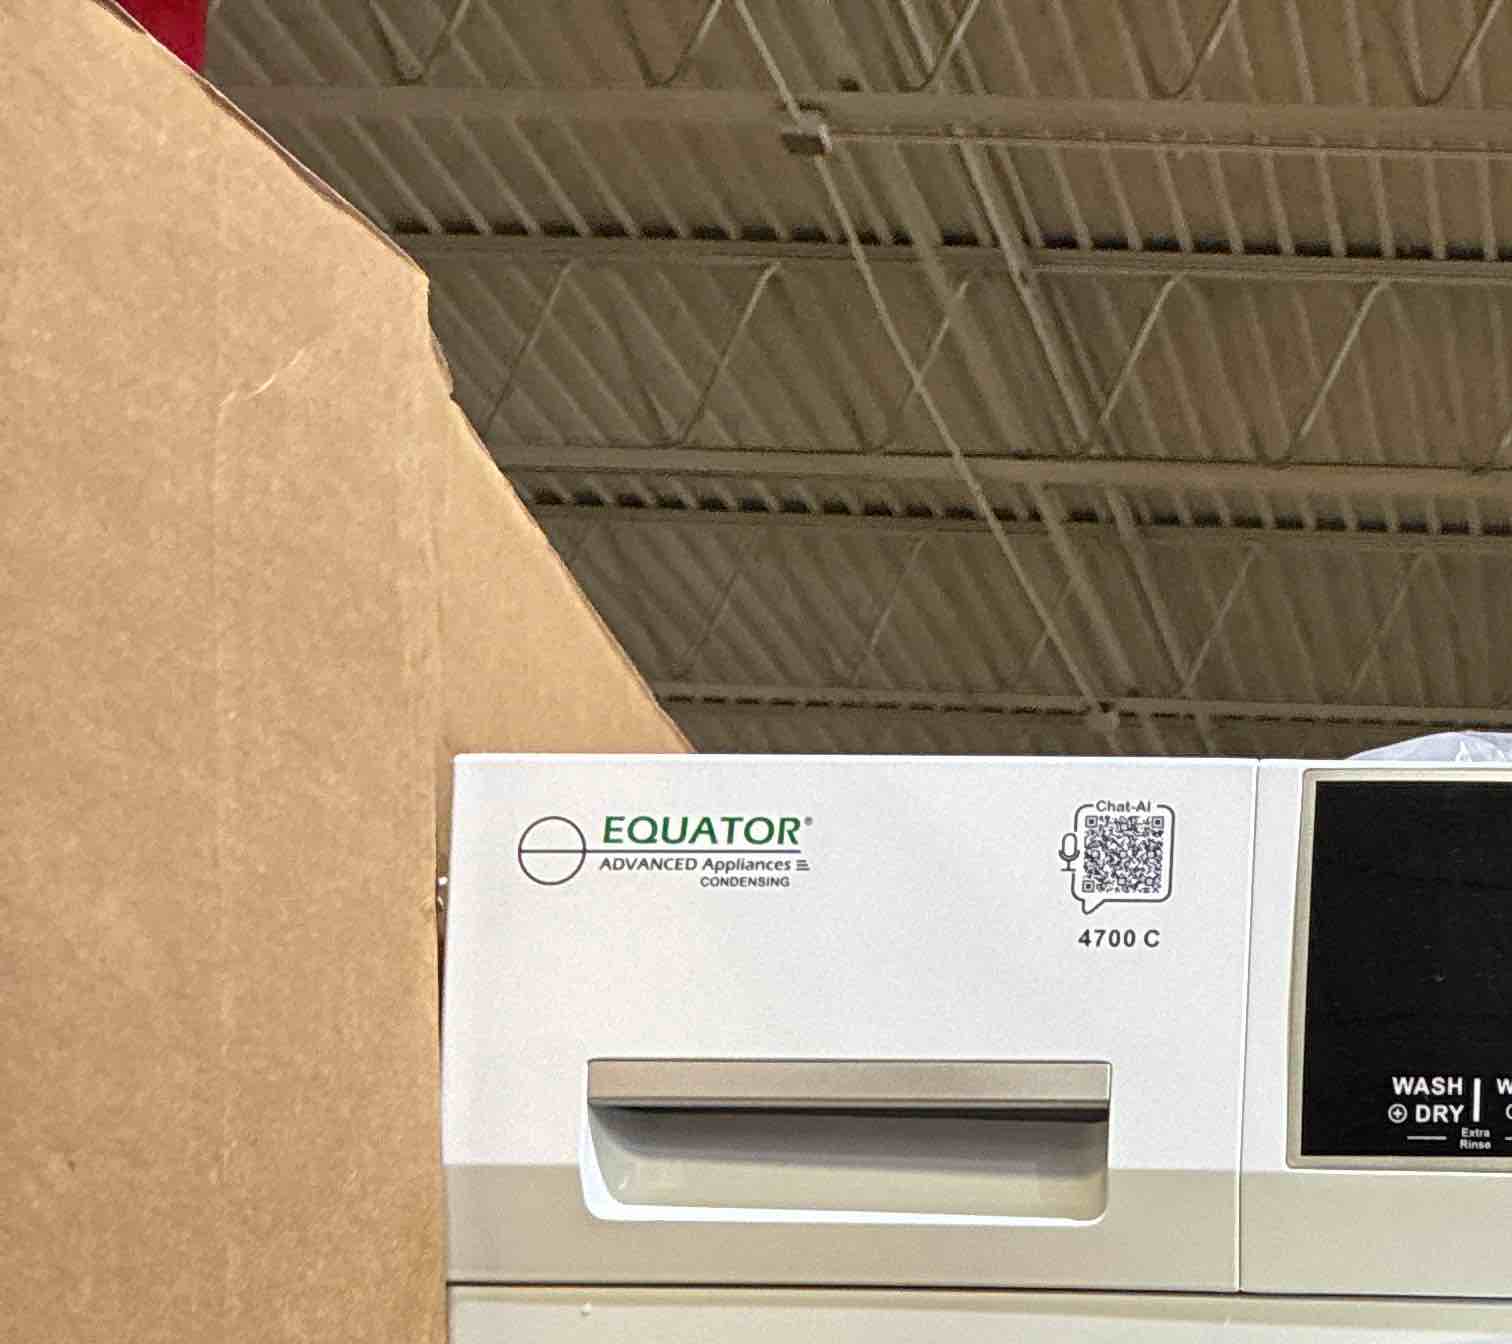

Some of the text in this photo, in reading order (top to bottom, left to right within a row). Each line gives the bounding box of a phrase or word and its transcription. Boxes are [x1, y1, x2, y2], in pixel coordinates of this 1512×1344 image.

[1095, 800, 1152, 812] Chat-AI
[600, 857, 791, 874] ADVANCED Appliances
[700, 876, 790, 888] CONDENSING
[1078, 929, 1161, 948] 4700 C
[1391, 1076, 1463, 1096] WASH
[1415, 1104, 1464, 1123] DRY
[1461, 1127, 1491, 1139] Extra
[1459, 1139, 1492, 1150] Rinse
